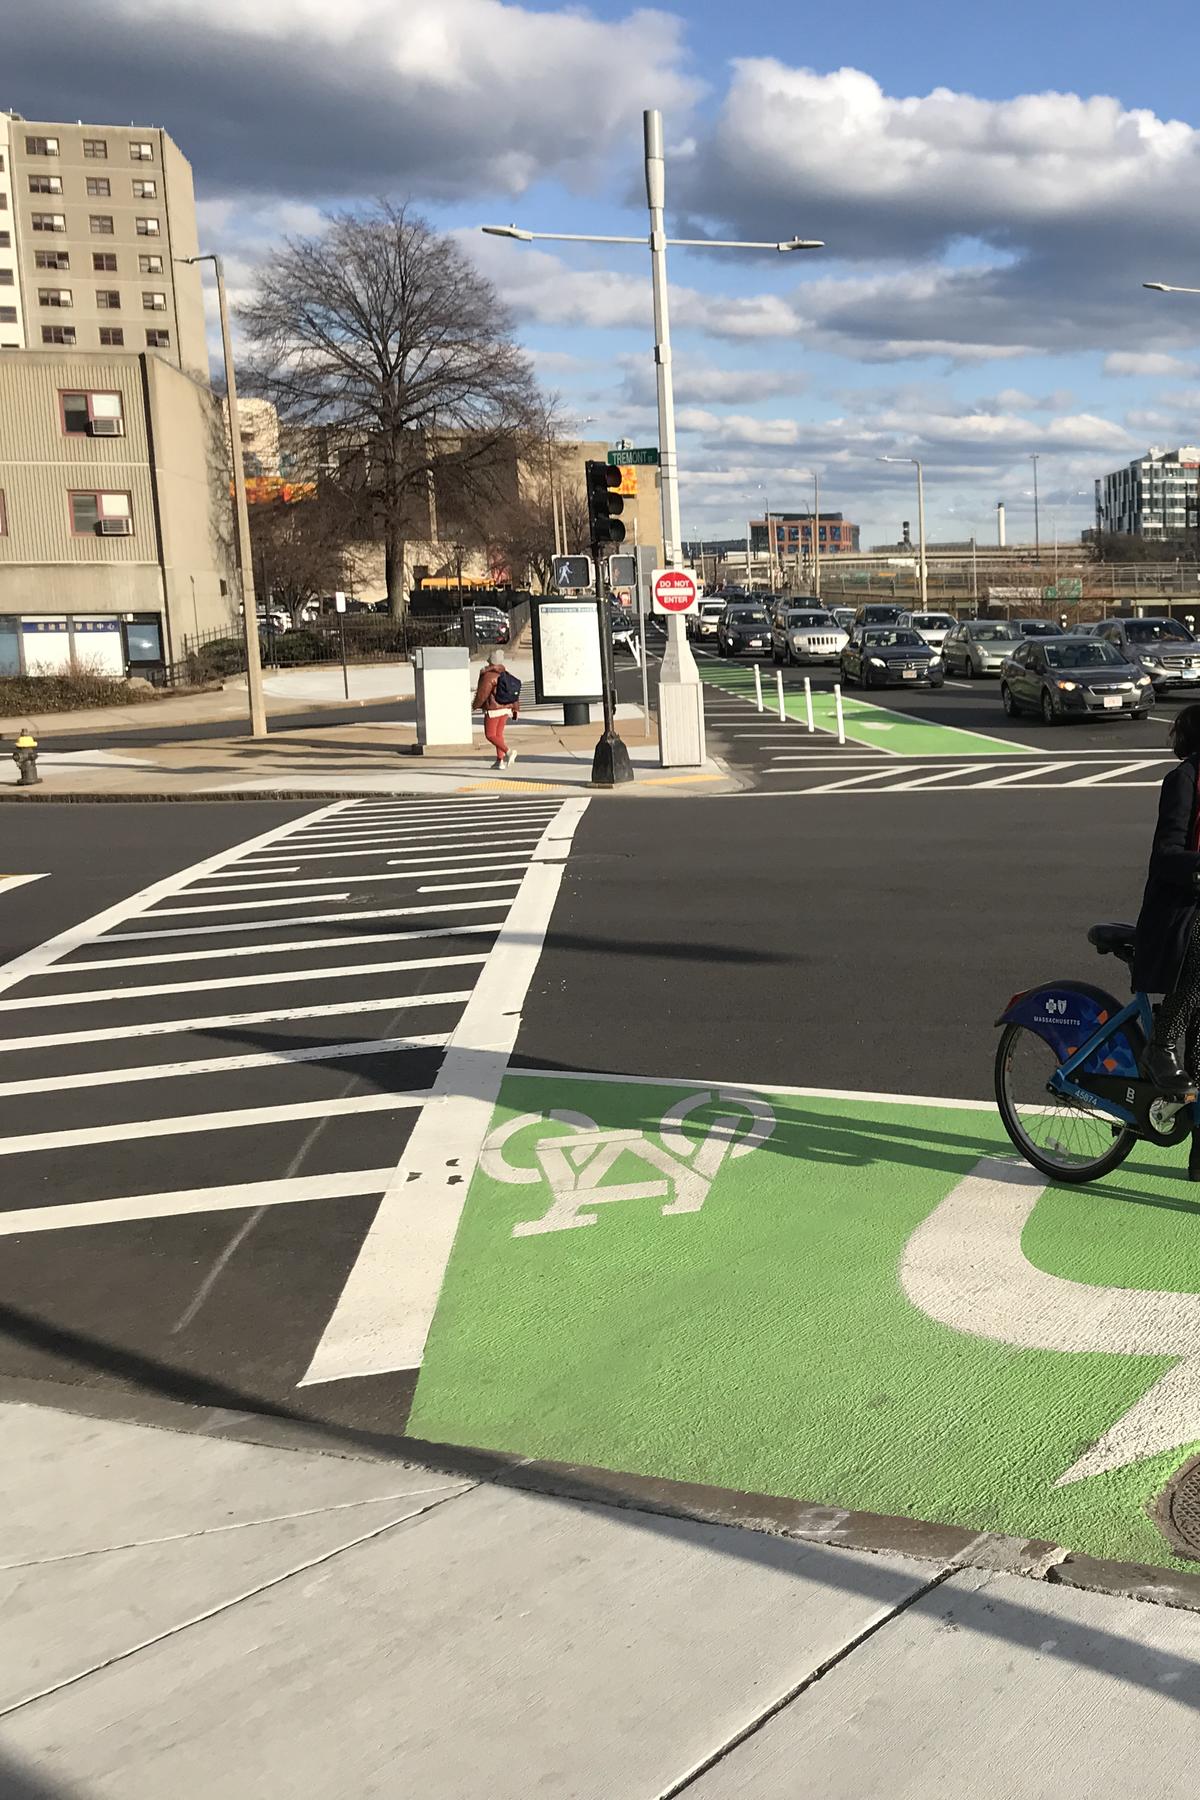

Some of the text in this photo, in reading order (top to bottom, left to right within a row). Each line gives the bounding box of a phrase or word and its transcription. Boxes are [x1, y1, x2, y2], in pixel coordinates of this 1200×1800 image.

[612, 451, 648, 465] TREMONT
[664, 596, 688, 604] ENTER
[1033, 1016, 1081, 1026] MASSACHUSETTS
